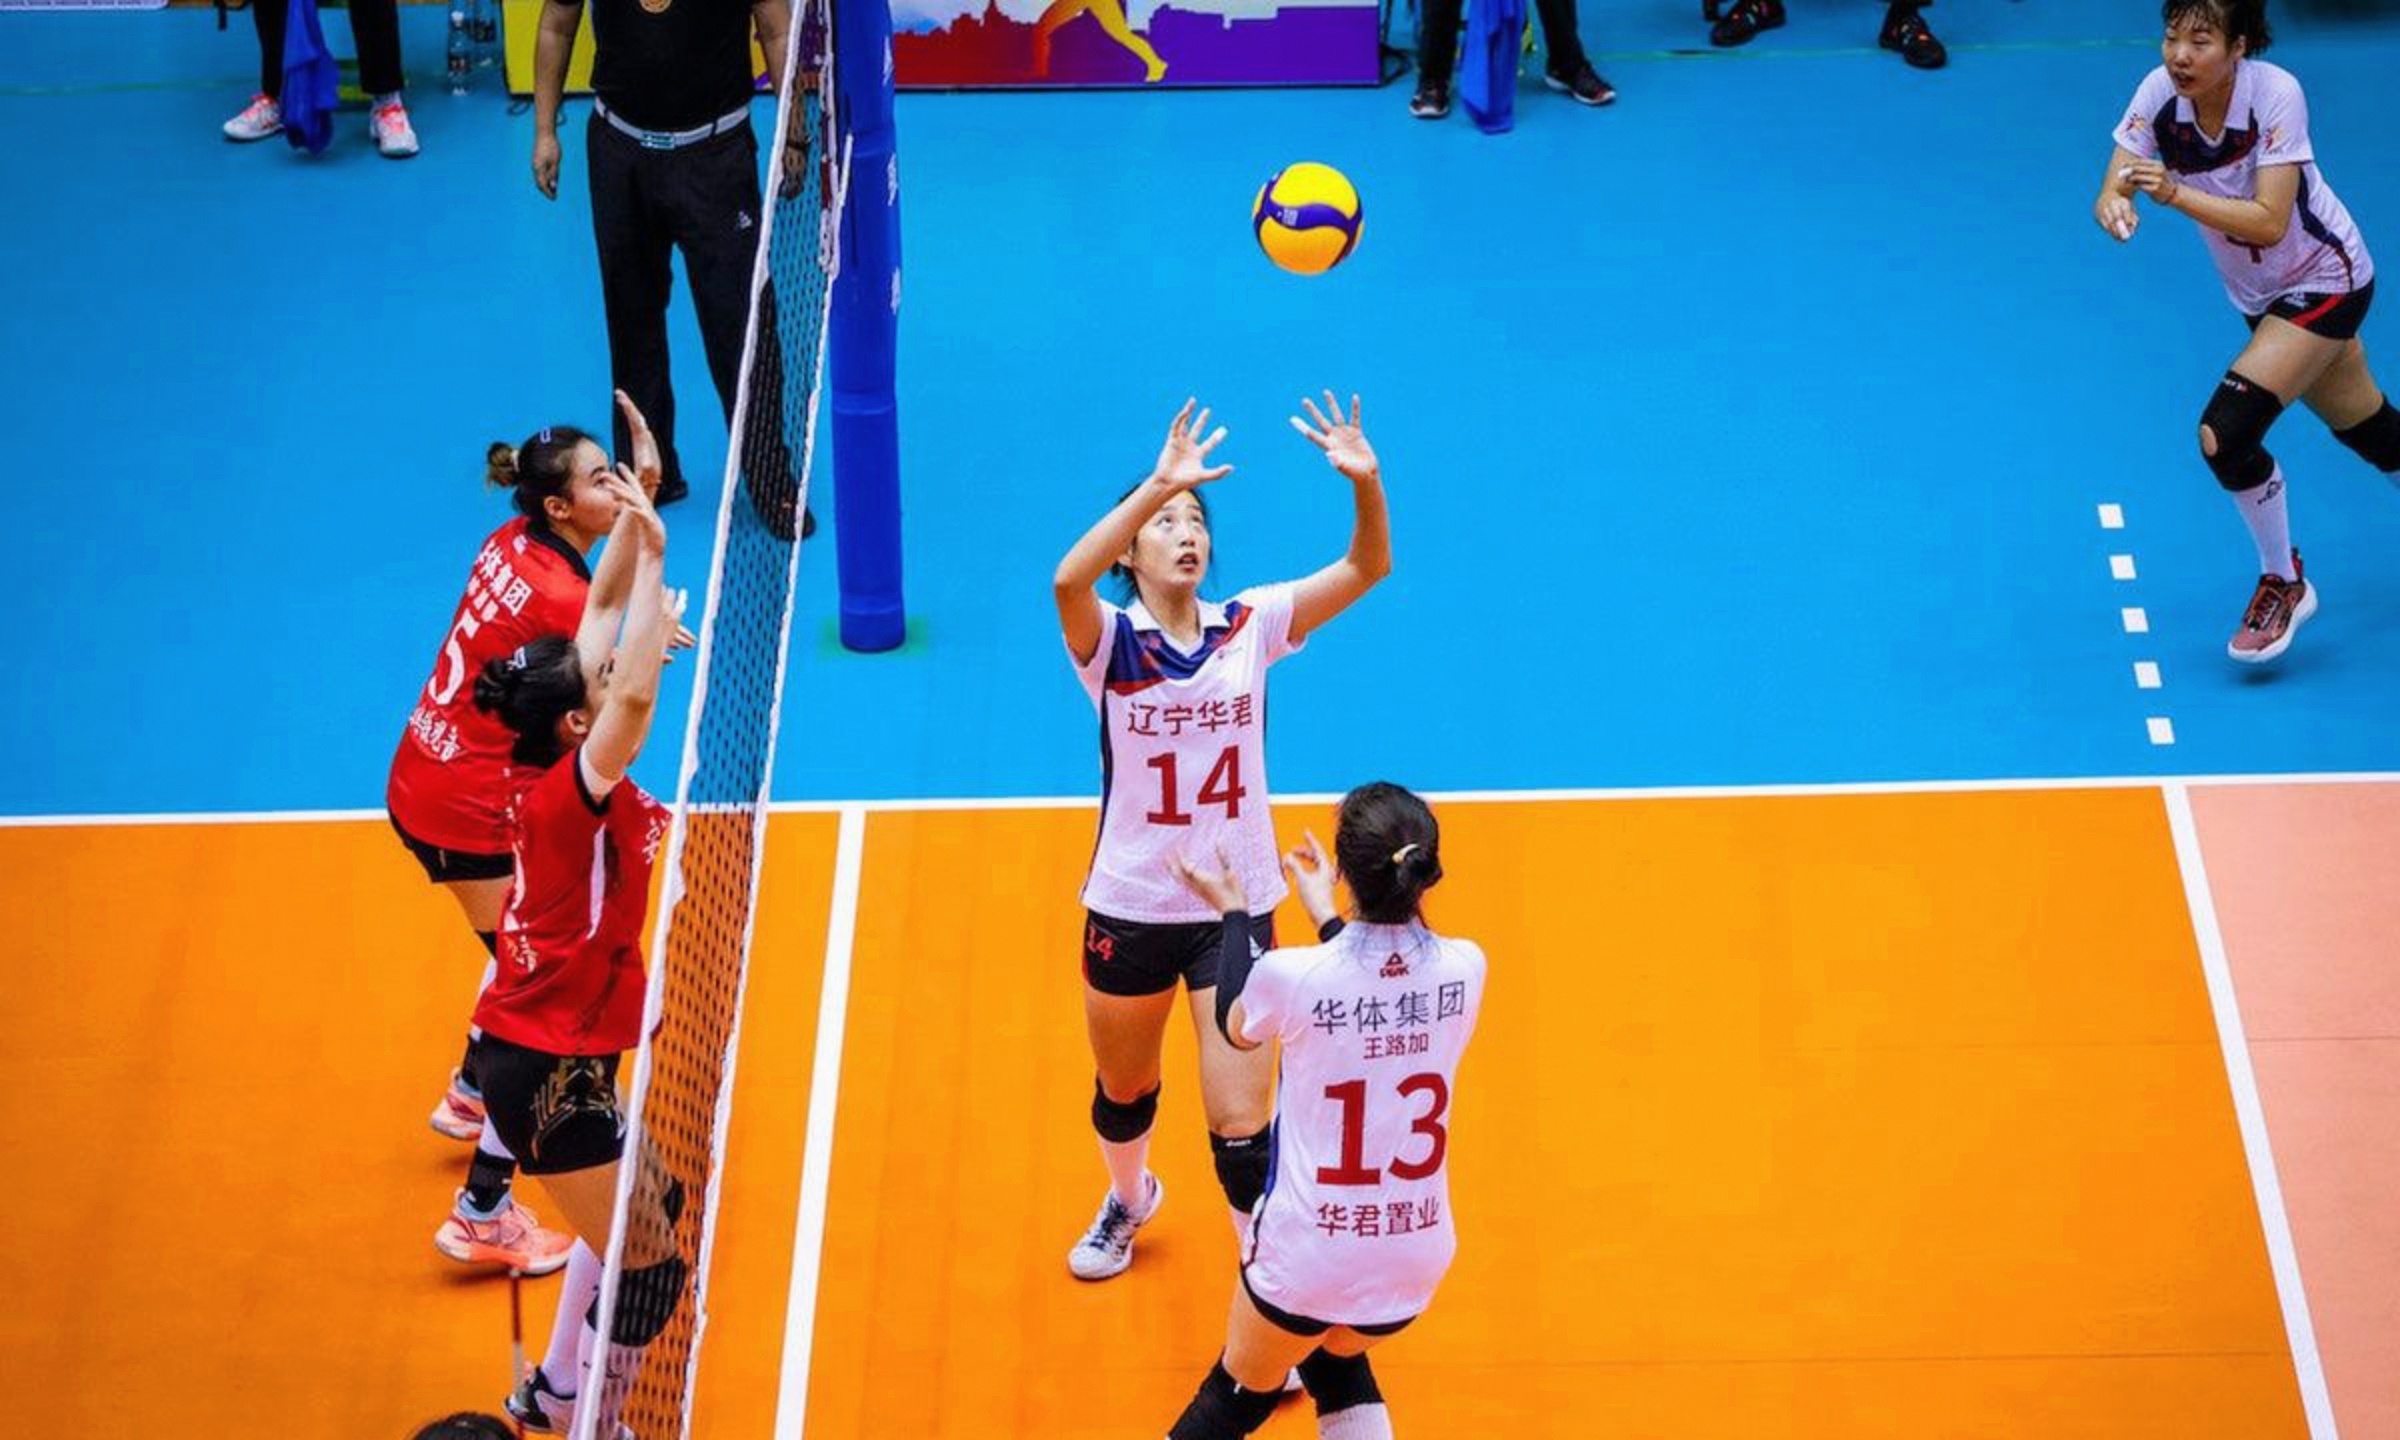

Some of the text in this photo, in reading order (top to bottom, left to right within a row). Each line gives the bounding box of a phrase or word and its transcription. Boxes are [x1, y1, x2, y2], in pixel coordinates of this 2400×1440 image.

[428, 608, 480, 704] 5
[1127, 693, 1252, 736] 辽宁华君
[1146, 745, 1246, 826] 14
[1312, 980, 1465, 1035] 华体集团
[1363, 1032, 1430, 1060] 王路加
[1316, 1071, 1449, 1186] 13
[1317, 1195, 1439, 1238] 华君置业
